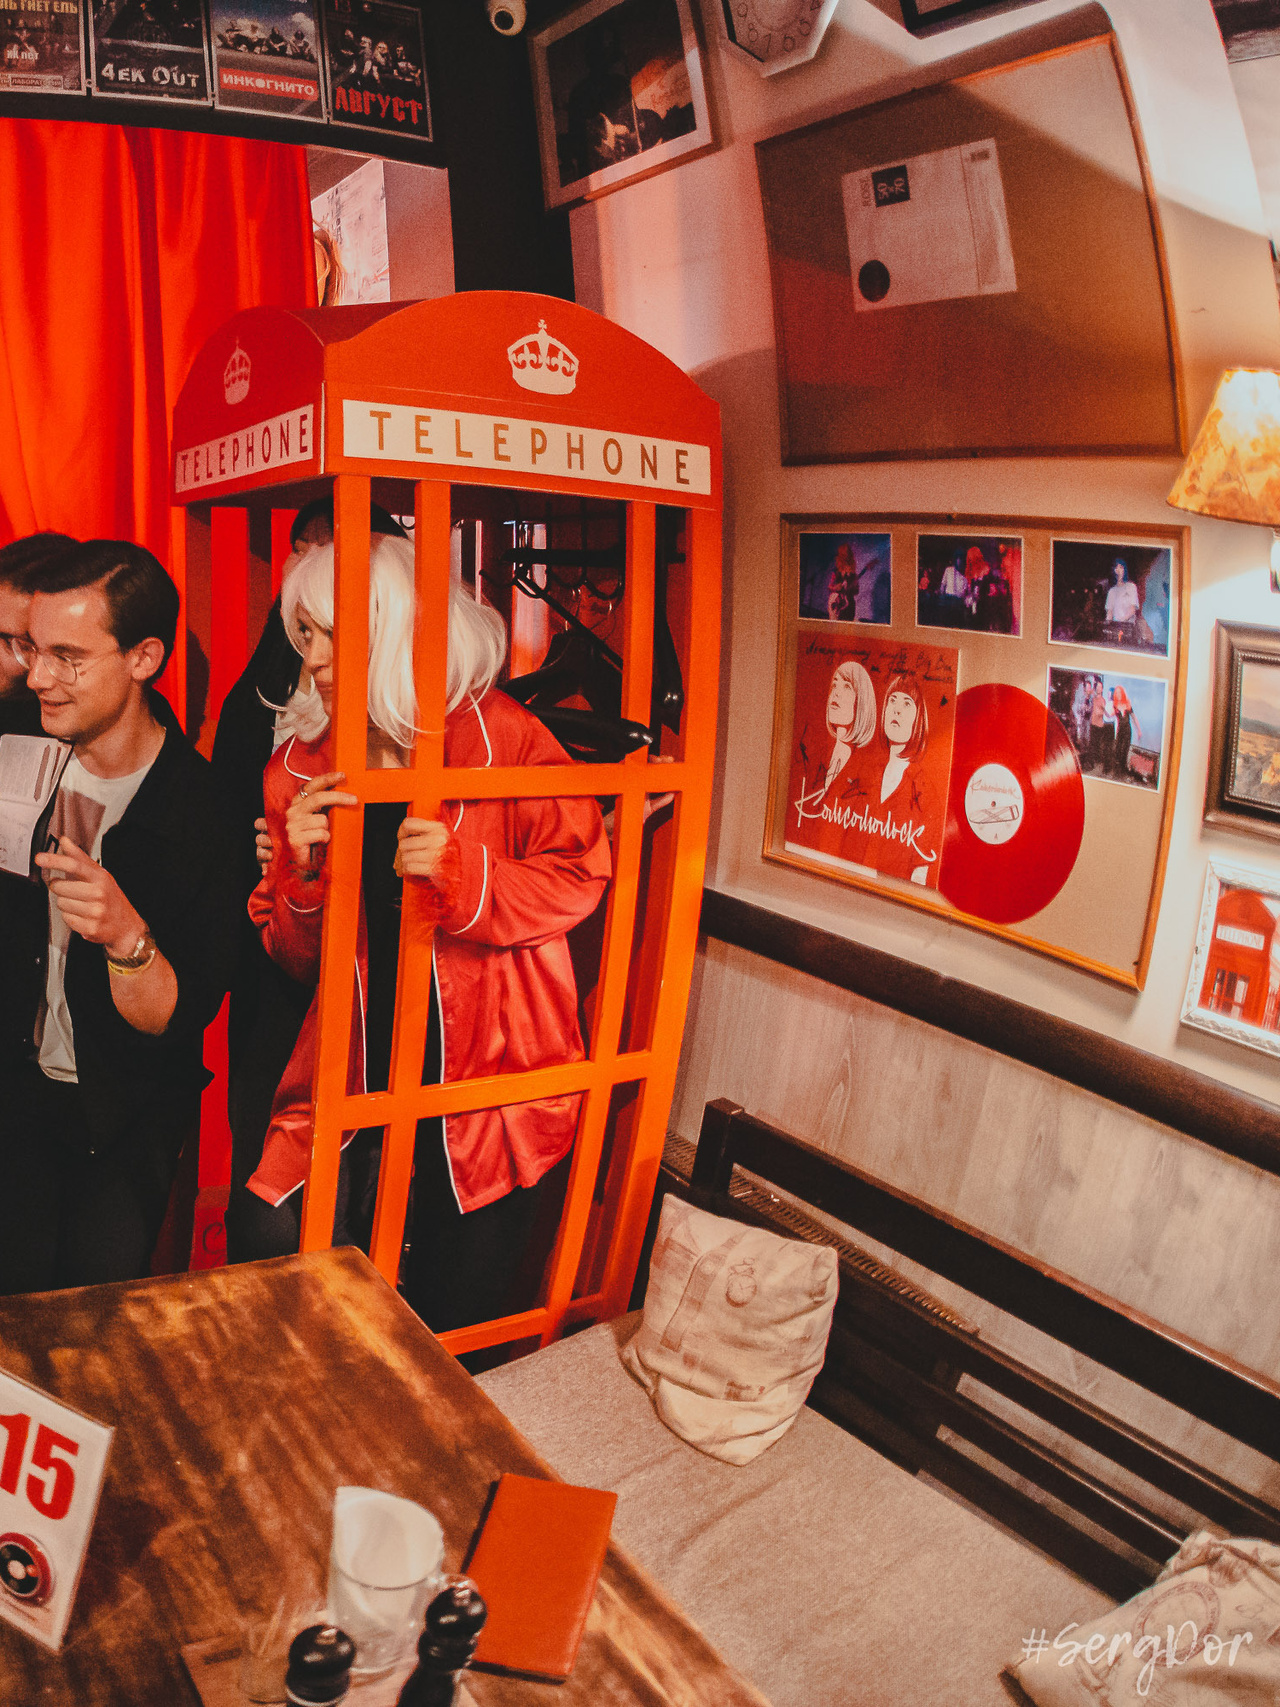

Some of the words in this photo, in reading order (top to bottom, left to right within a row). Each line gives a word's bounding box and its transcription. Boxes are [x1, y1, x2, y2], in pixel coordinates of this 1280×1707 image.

[223, 73, 315, 96] ИНКОГНИТО
[335, 86, 423, 125] АВГУСТ
[181, 414, 308, 483] TELEPHONE
[368, 409, 691, 486] TELEPHONE
